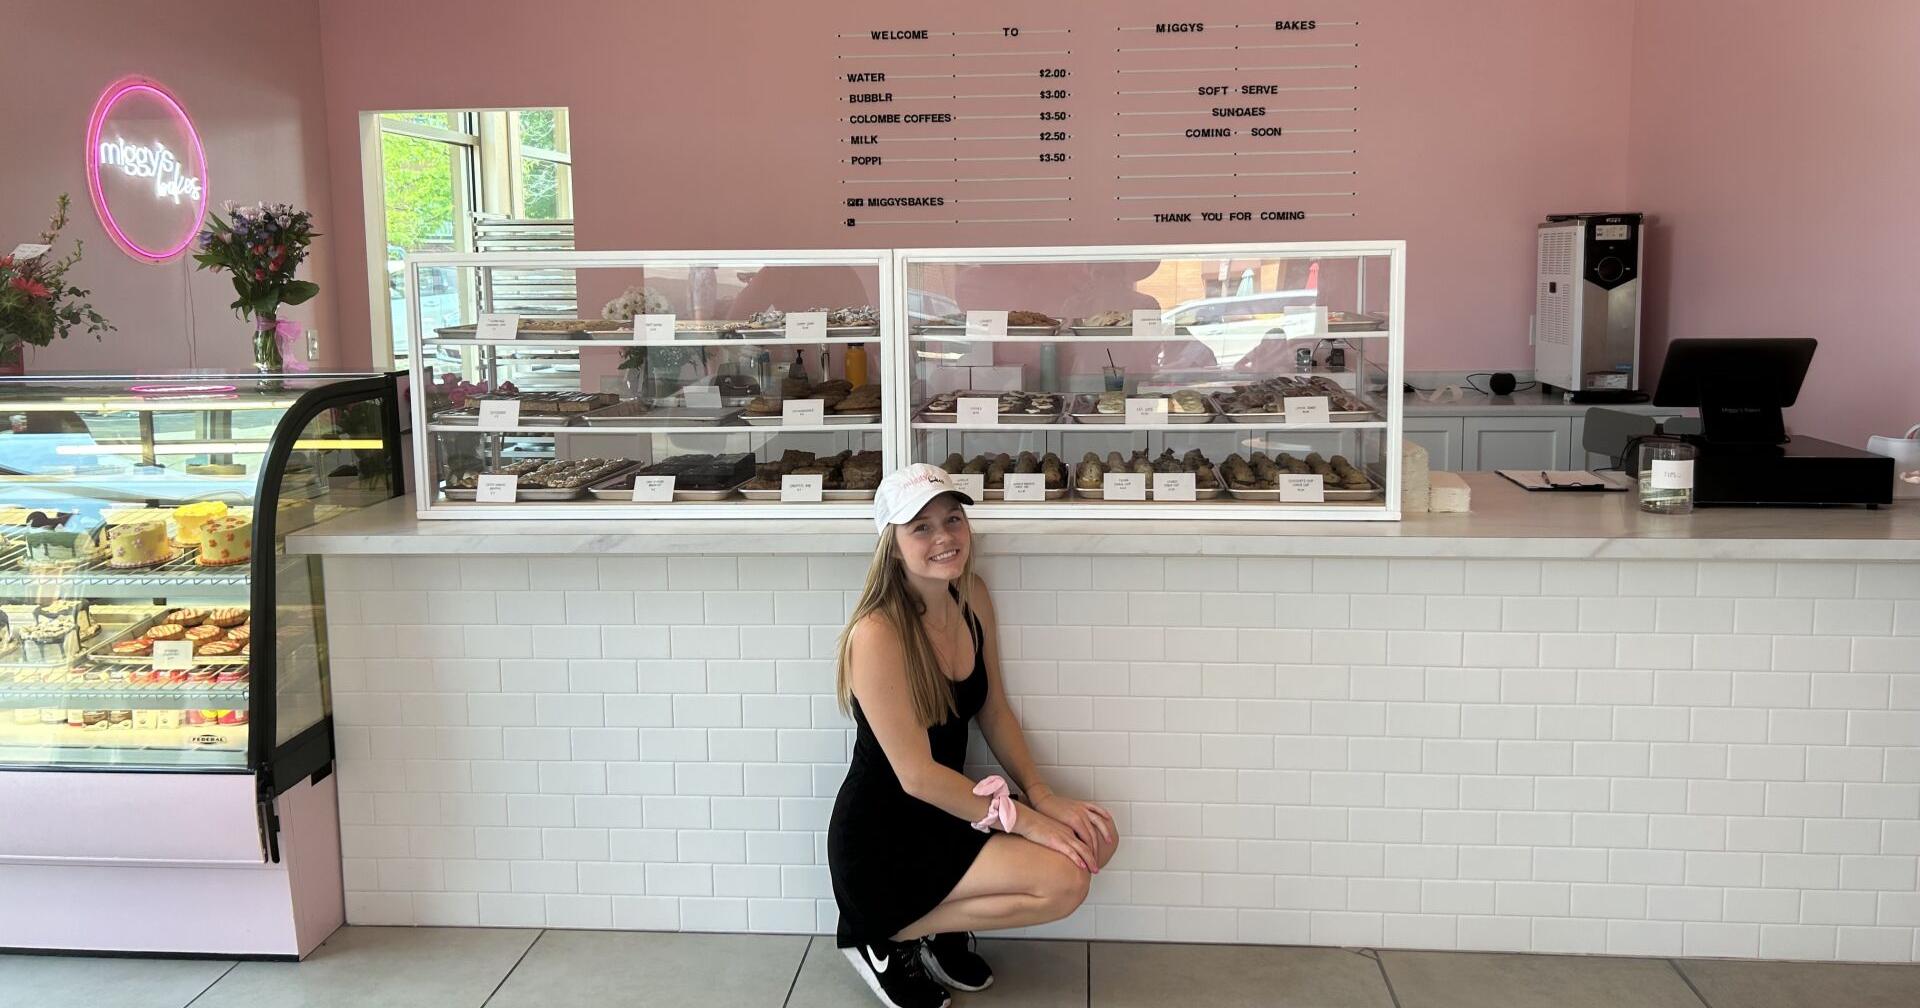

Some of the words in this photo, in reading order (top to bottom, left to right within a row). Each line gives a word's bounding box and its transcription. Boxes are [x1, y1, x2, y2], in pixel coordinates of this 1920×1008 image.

[1156, 23, 1203, 33] MIGGYS
[1276, 21, 1315, 30] BAKES
[871, 30, 928, 40] WELCOME
[1003, 28, 1018, 36] TO
[847, 73, 885, 82] WATER
[1040, 69, 1066, 77] $2.00
[1198, 86, 1228, 95] SOFT
[1242, 85, 1278, 94] SERVE
[850, 93, 892, 103] BUBBLR
[1040, 90, 1066, 99] $3.00
[850, 114, 900, 124] COLOMBE
[904, 114, 951, 123] COFFEES
[1040, 112, 1066, 120] $3.50
[1212, 107, 1265, 117] SUNDAES
[851, 136, 878, 144] MILK
[1040, 132, 1065, 141] $2.50
[1186, 128, 1230, 137] COMING
[1251, 128, 1281, 136] SOON
[100, 137, 175, 176] miggy's
[852, 157, 881, 165] POPPI
[1040, 153, 1065, 162] $3.50
[157, 161, 202, 204] bakes
[868, 197, 944, 206] MIGGYSBAKES
[1154, 214, 1191, 222] THANK
[1201, 213, 1222, 221] YOU
[1230, 212, 1251, 221] FOR
[1261, 211, 1305, 220] COMING
